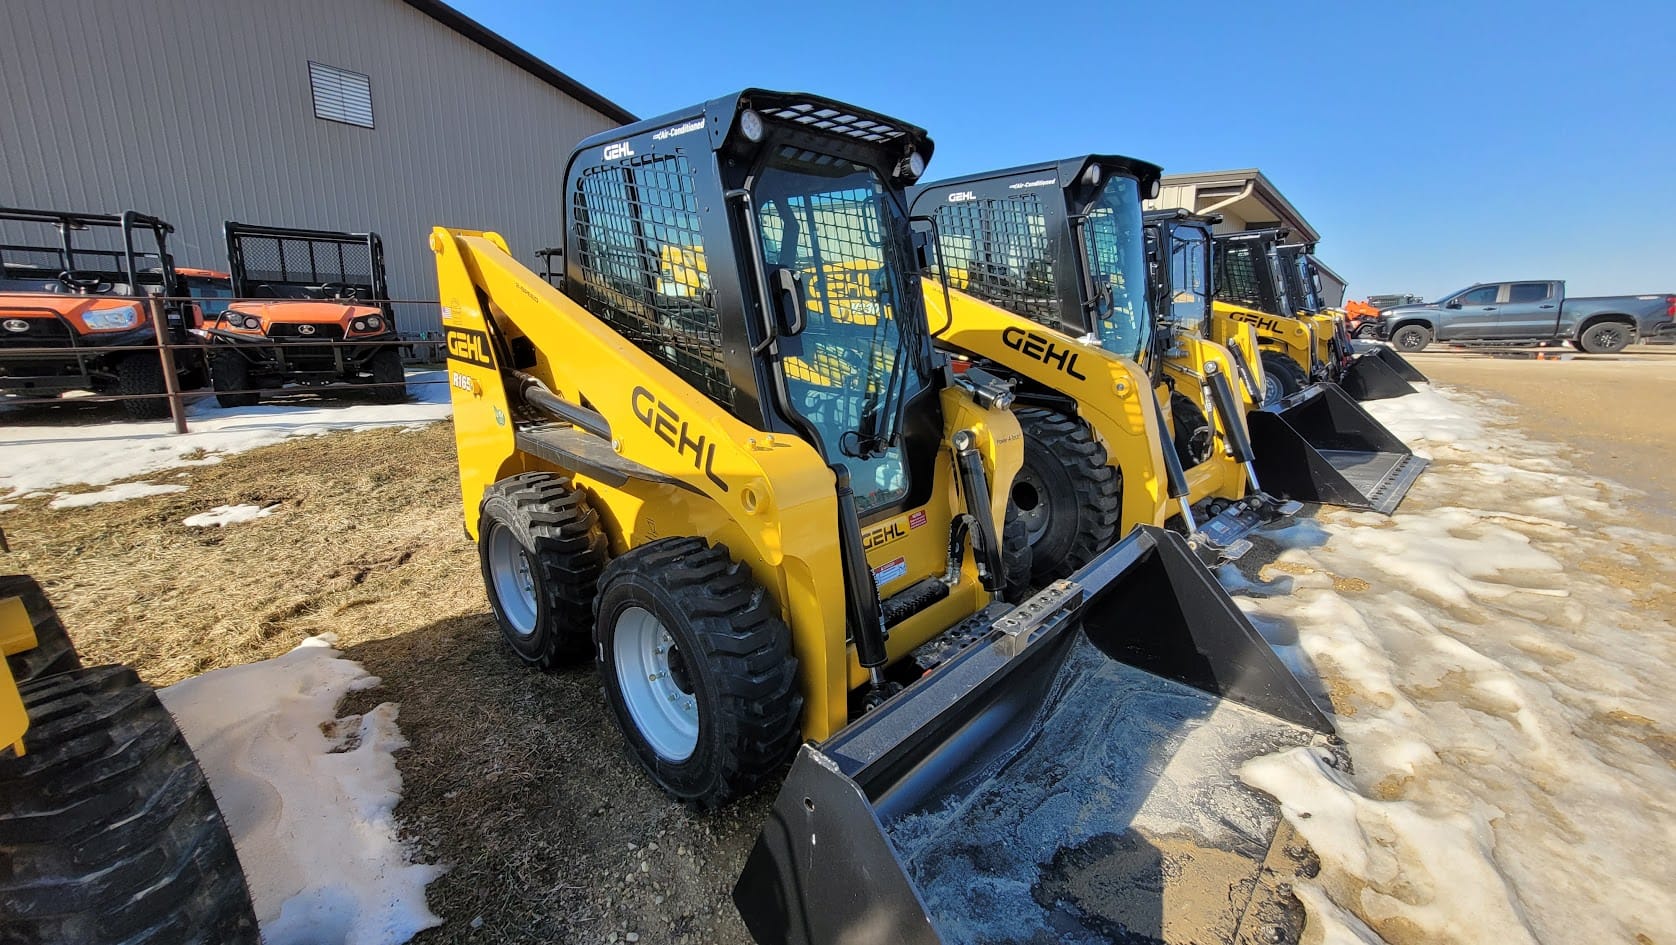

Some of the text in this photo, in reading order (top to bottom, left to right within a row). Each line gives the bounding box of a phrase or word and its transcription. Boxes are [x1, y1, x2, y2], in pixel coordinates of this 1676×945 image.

[603, 142, 635, 160] GEHL
[948, 191, 976, 202] GEHL
[1229, 311, 1284, 334] GEHL
[447, 331, 490, 363] GEHL
[1002, 326, 1086, 381] GEHL
[453, 372, 472, 391] R165
[632, 386, 728, 492] GEHL
[862, 523, 905, 550] GEHL
